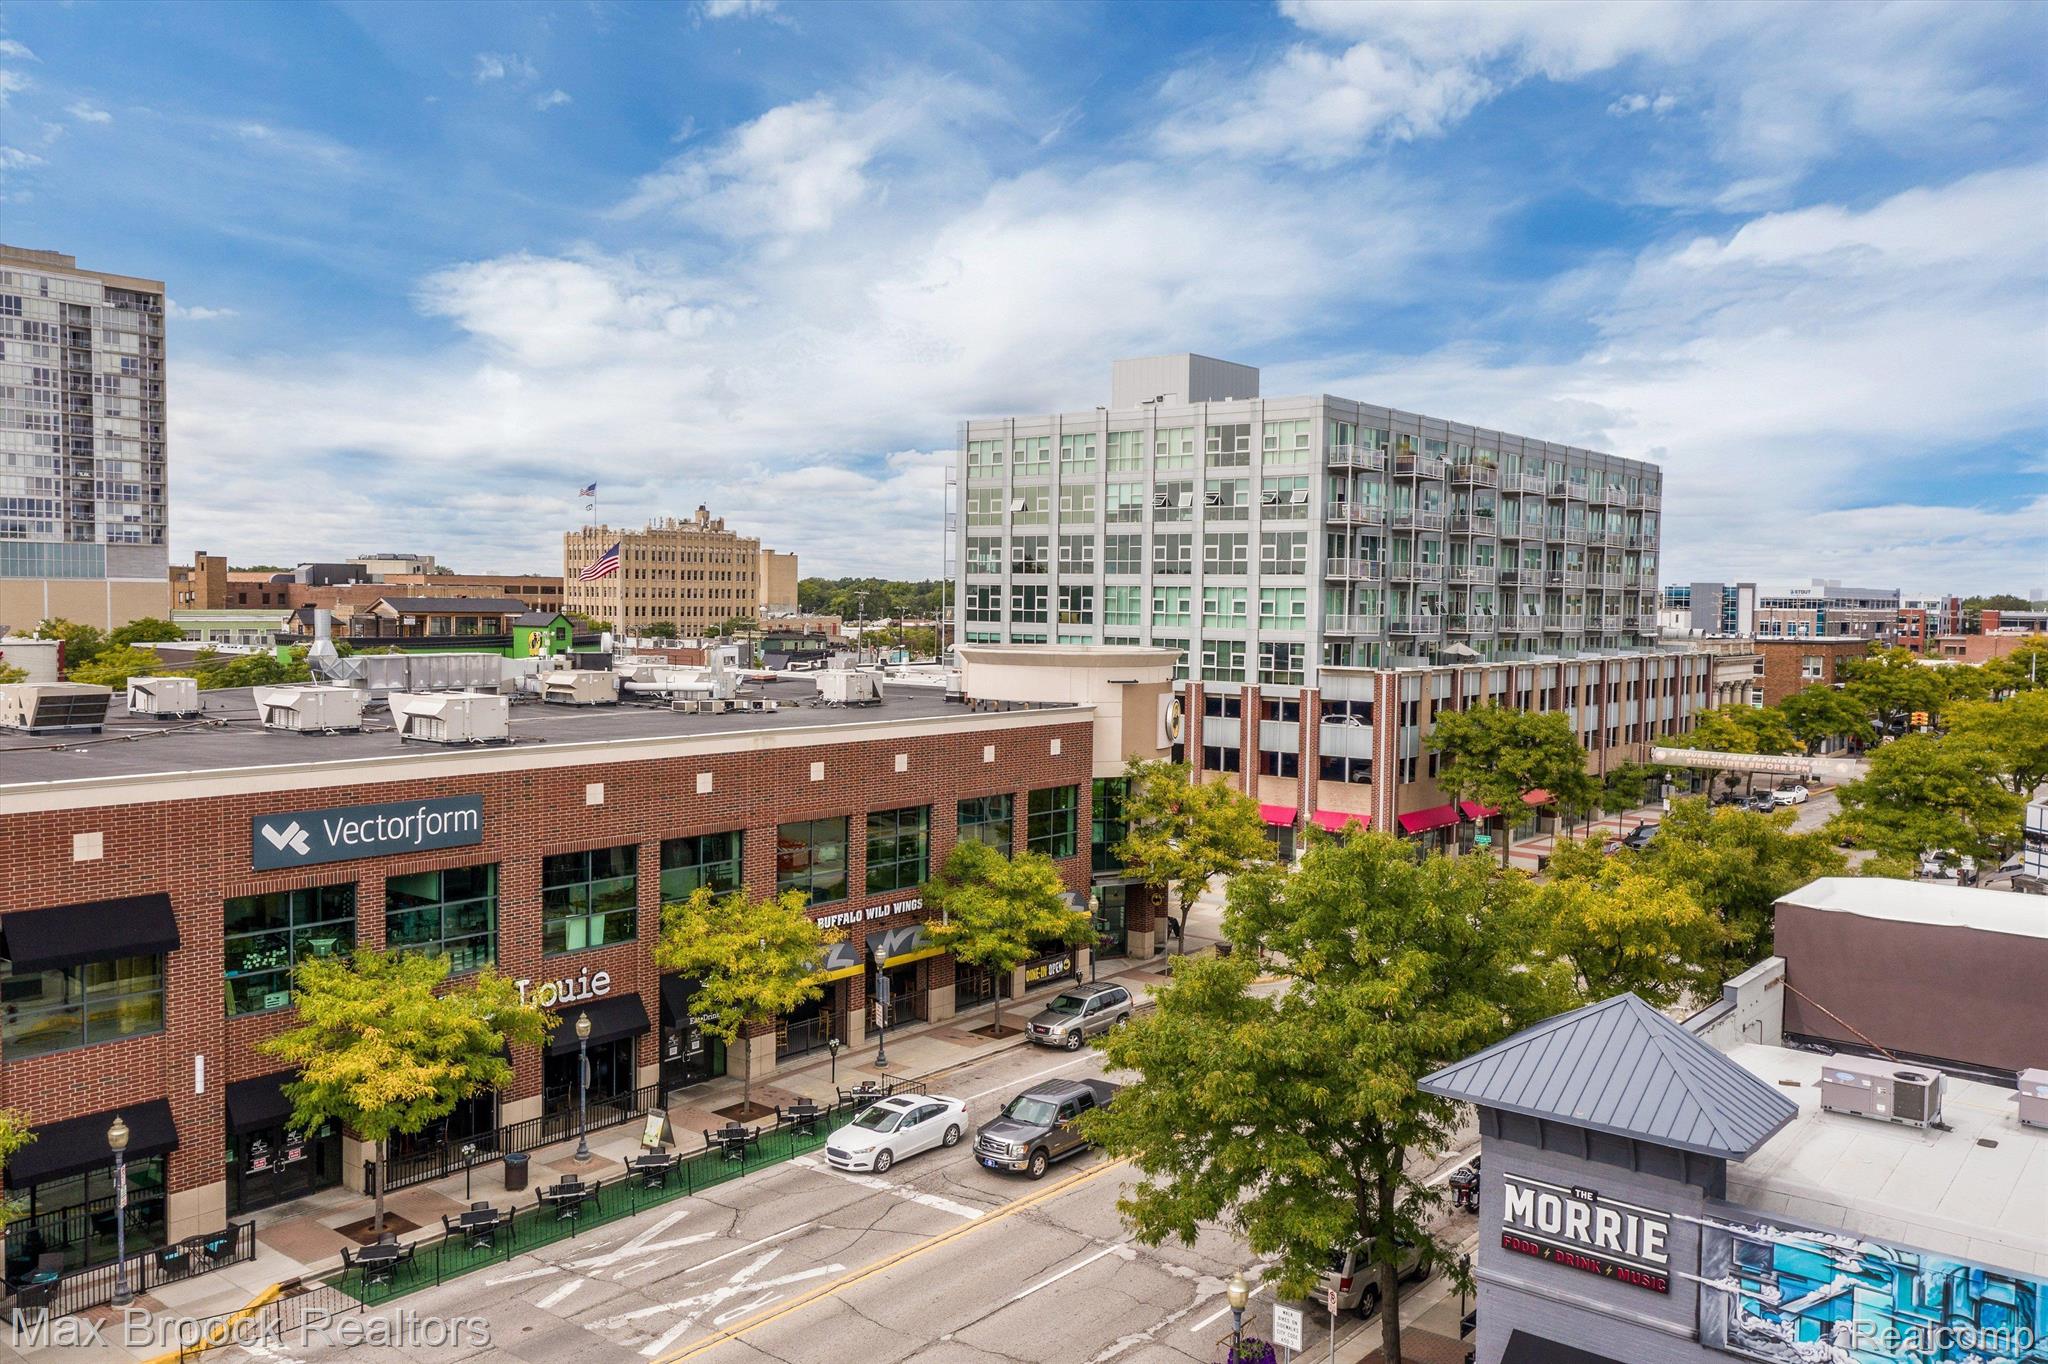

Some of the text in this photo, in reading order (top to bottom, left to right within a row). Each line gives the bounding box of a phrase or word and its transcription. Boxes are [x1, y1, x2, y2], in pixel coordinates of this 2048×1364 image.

[1678, 751, 1708, 759] HOURS
[1686, 758, 1810, 773] STRUCTURES BEFORE 5PM
[323, 807, 478, 846] Vectorform
[817, 899, 923, 929] BUFFALO WILD WINGS
[1048, 960, 1063, 976] OPEN
[1574, 1188, 1594, 1201] THE
[1503, 1183, 1668, 1264] MORRIE
[1503, 1235, 1667, 1291] FOOD DRINK MUSIC
